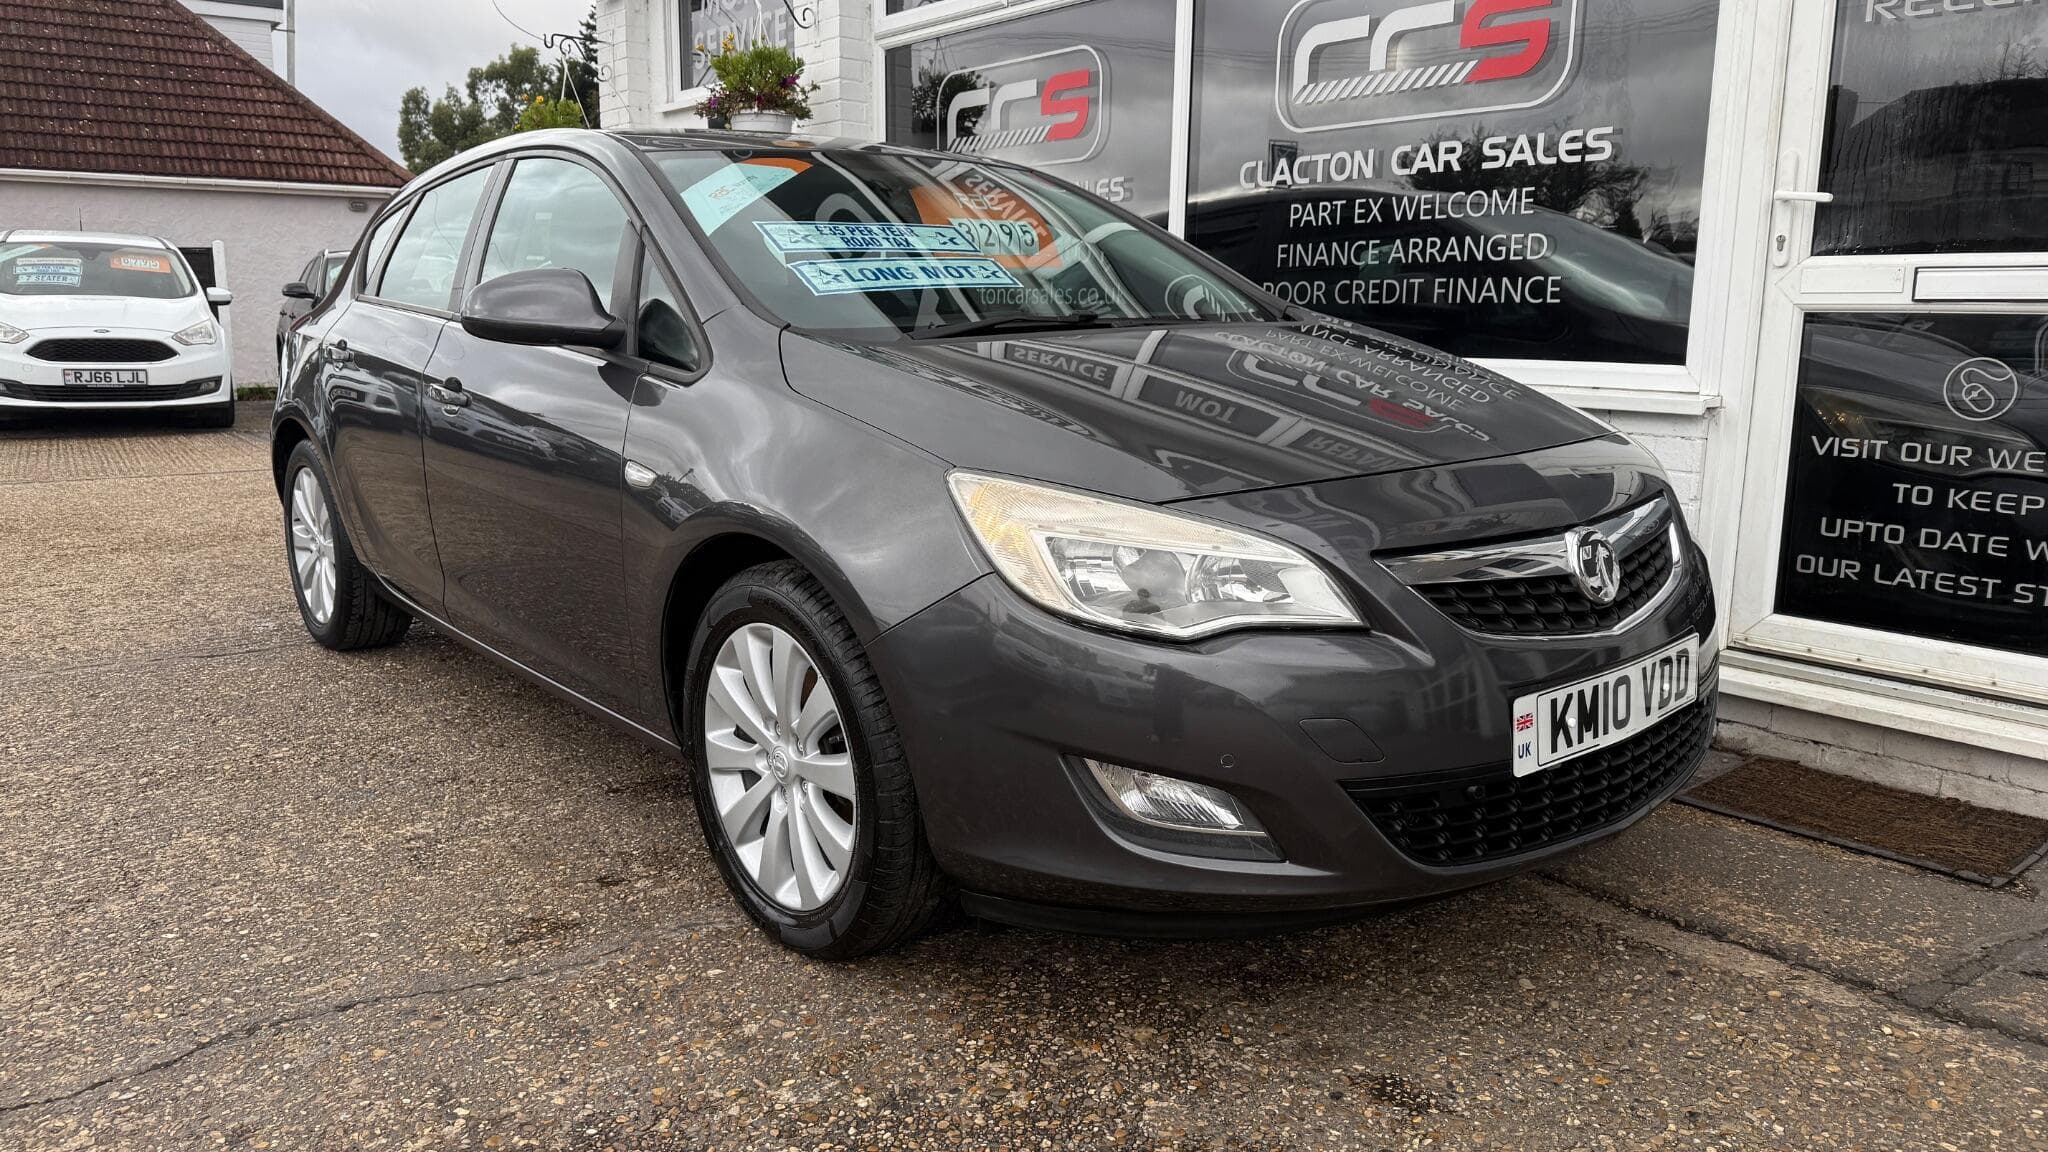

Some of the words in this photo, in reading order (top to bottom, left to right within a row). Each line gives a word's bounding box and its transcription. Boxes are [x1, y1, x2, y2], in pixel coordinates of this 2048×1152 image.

[1239, 150, 1374, 188] CLACTON
[1391, 140, 1463, 176] CAR
[1481, 126, 1614, 170] SALES
[1290, 200, 1346, 228] PART
[1354, 197, 1384, 224] EX
[1393, 187, 1537, 221] WELCOME
[815, 225, 845, 237] £35
[849, 225, 877, 238] PER
[879, 225, 921, 239] YEAR
[841, 236, 881, 248] ROAD
[886, 237, 916, 249] TAX
[1277, 240, 1380, 268] FINANCE
[1388, 233, 1549, 265] ARRANGED
[842, 267, 917, 283] LONG
[918, 265, 975, 281] MOT
[1334, 277, 1425, 305] CREDIT
[1433, 276, 1562, 304] FINANCE
[74, 371, 112, 383] RJ66
[116, 371, 145, 383] LJL
[1811, 435, 1889, 460] VISIT
[1900, 442, 1972, 467] OUR
[1893, 483, 1933, 506] TO
[1947, 488, 2046, 515] KEEP
[1820, 516, 1905, 544] UPTO
[1919, 528, 2010, 557] DATE
[1796, 554, 1861, 580] OUR
[1873, 564, 2001, 599] LATEST
[1550, 675, 1632, 754] KM10
[1642, 648, 1690, 718] VDD
[1518, 741, 1532, 759] UK
